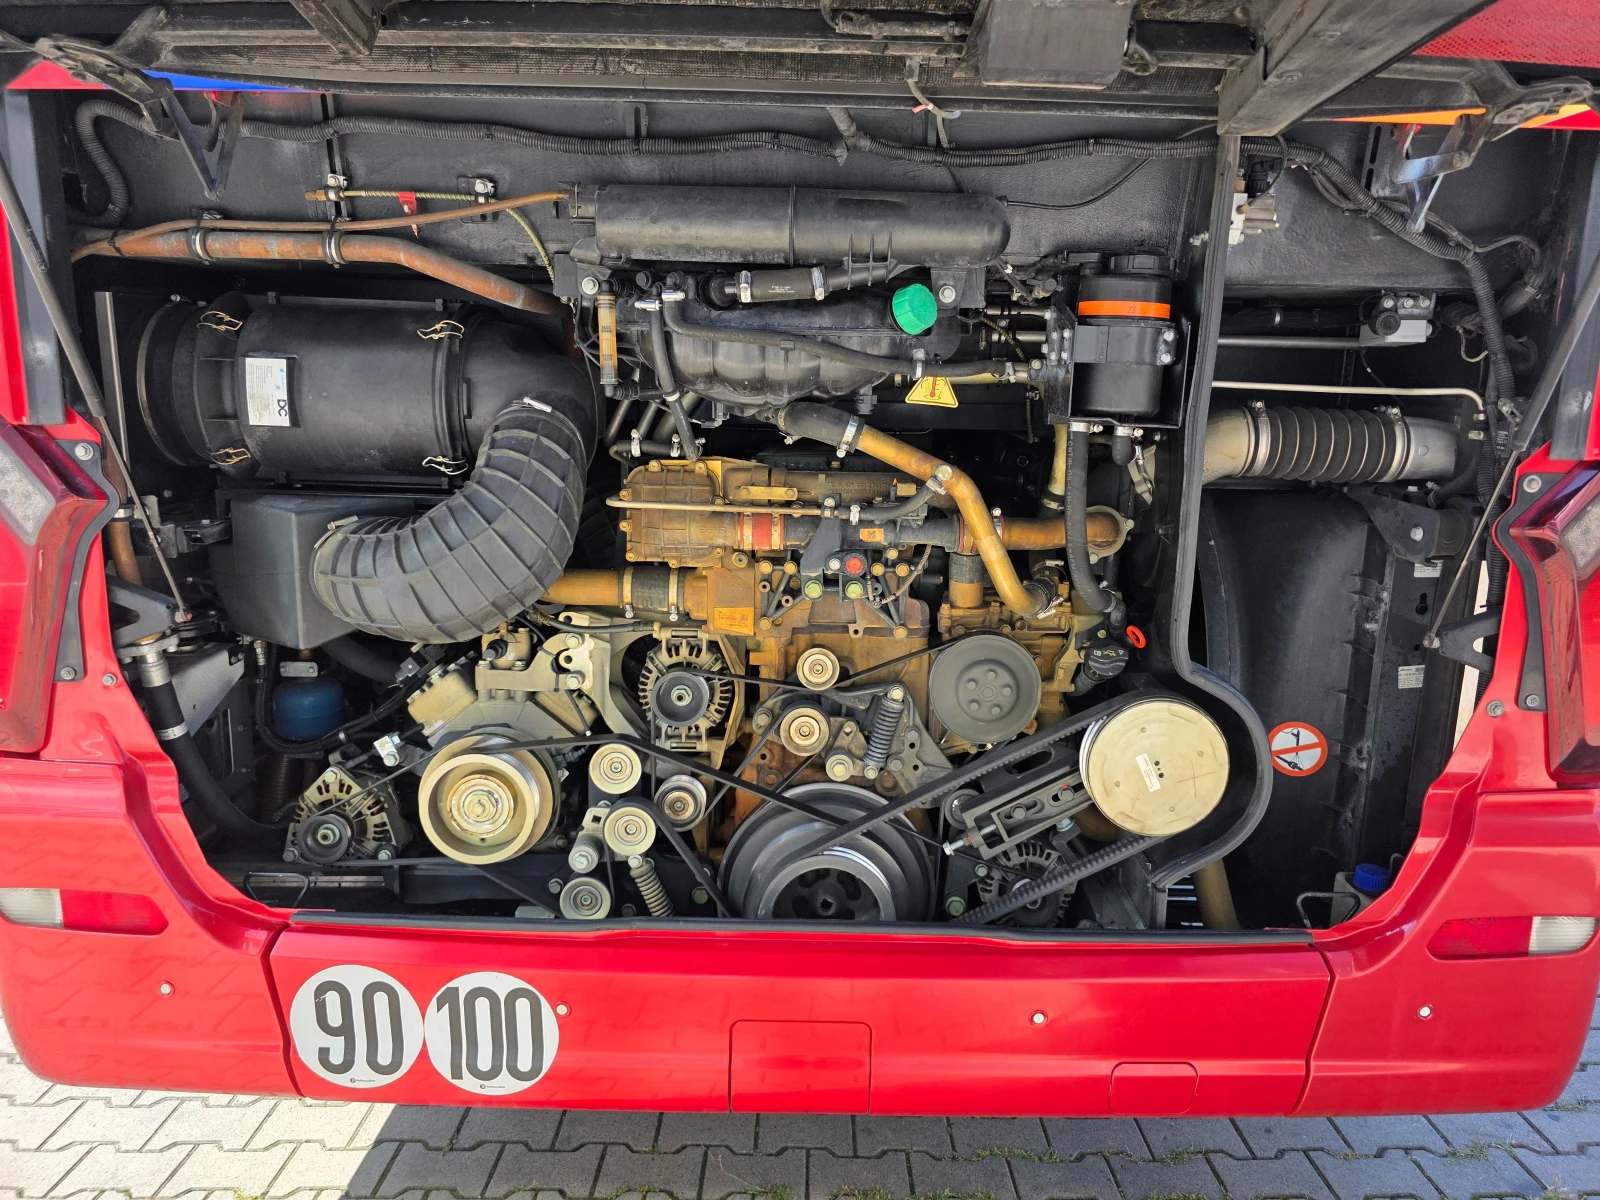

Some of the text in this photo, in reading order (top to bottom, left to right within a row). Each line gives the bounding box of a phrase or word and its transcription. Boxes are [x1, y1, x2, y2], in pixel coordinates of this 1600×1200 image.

[277, 398, 288, 417] DC
[313, 979, 405, 1076] 90
[435, 986, 545, 1082] 100
